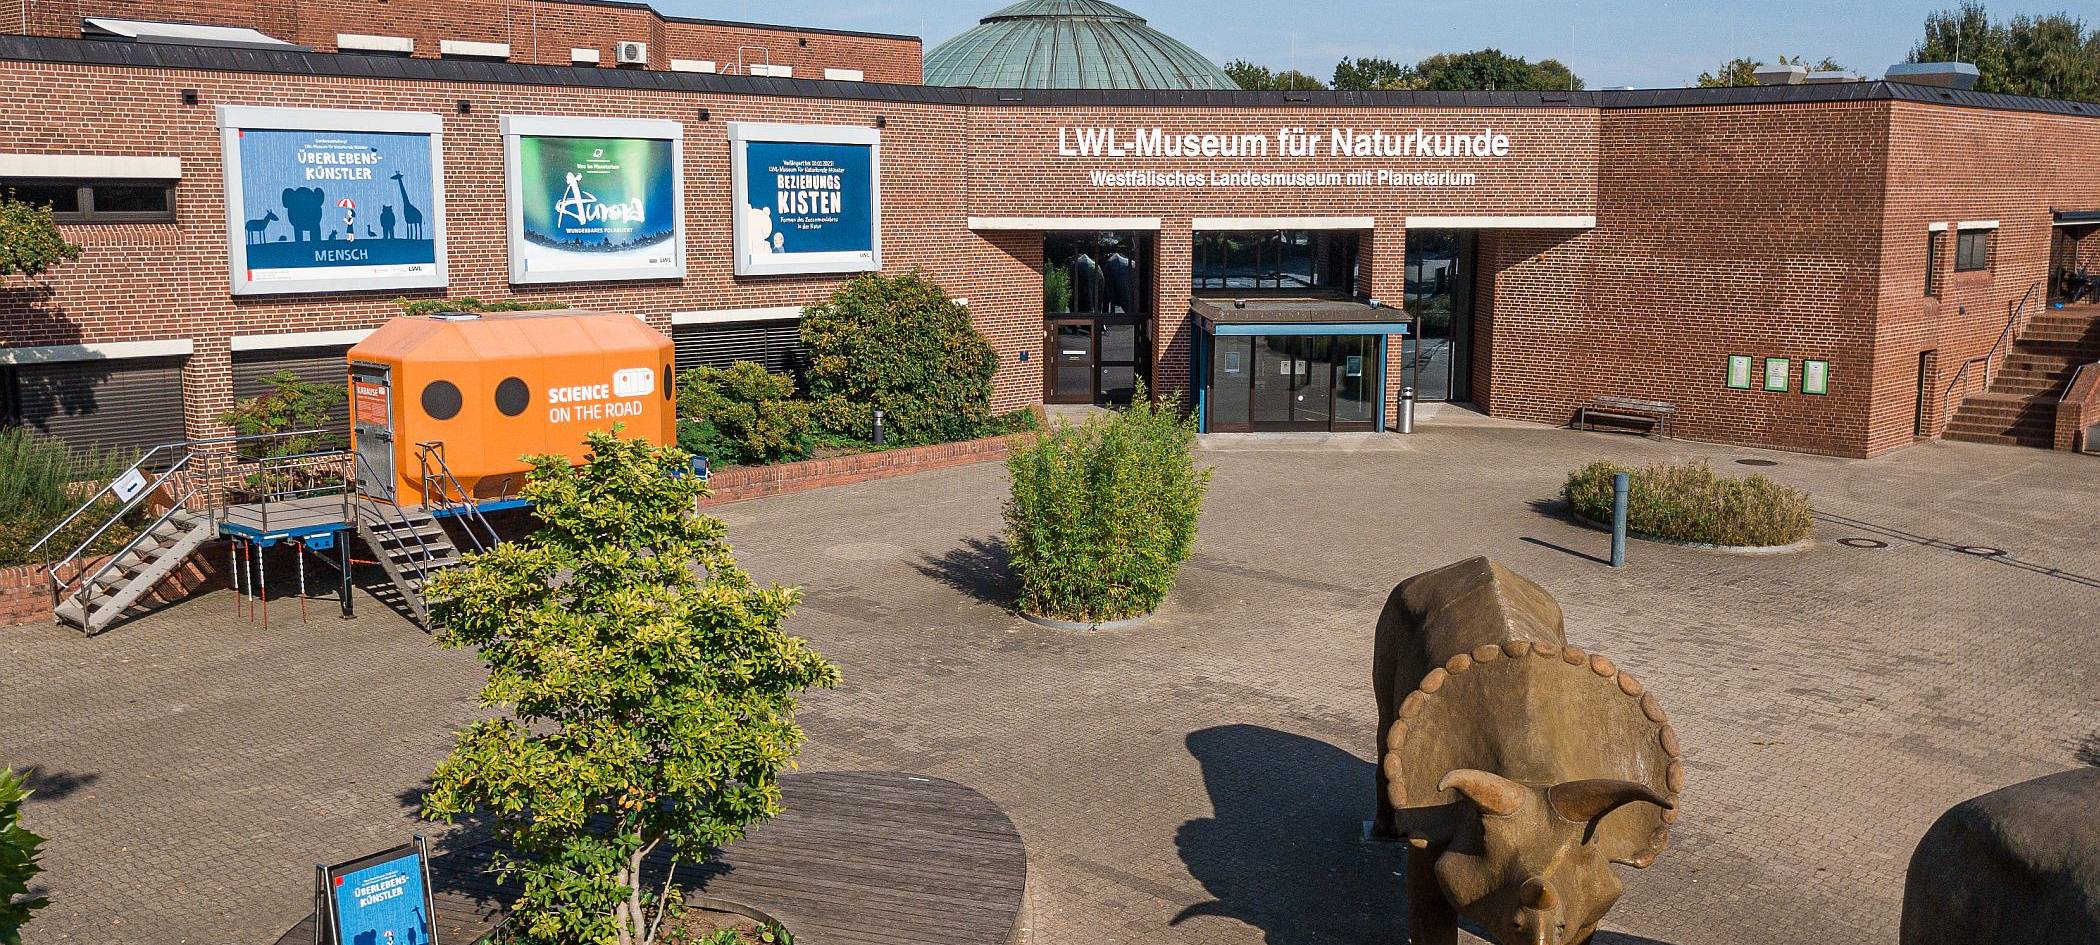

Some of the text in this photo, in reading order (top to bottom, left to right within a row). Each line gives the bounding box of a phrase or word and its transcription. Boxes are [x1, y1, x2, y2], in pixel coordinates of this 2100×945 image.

[1058, 128, 1510, 157] LWL-Museum für Naturkunde
[297, 149, 383, 165] ÜBERLEBENS-
[305, 166, 372, 181] KÜNSTLER
[777, 174, 841, 190] BEZIEHUNGS
[1090, 169, 1476, 187] Westfälisches Landesmuseum mit Planetarium
[777, 191, 842, 215] KISTEN
[314, 248, 369, 262] MENSCH
[548, 384, 610, 404] SCIENCE
[549, 400, 643, 423] ON THE ROAD
